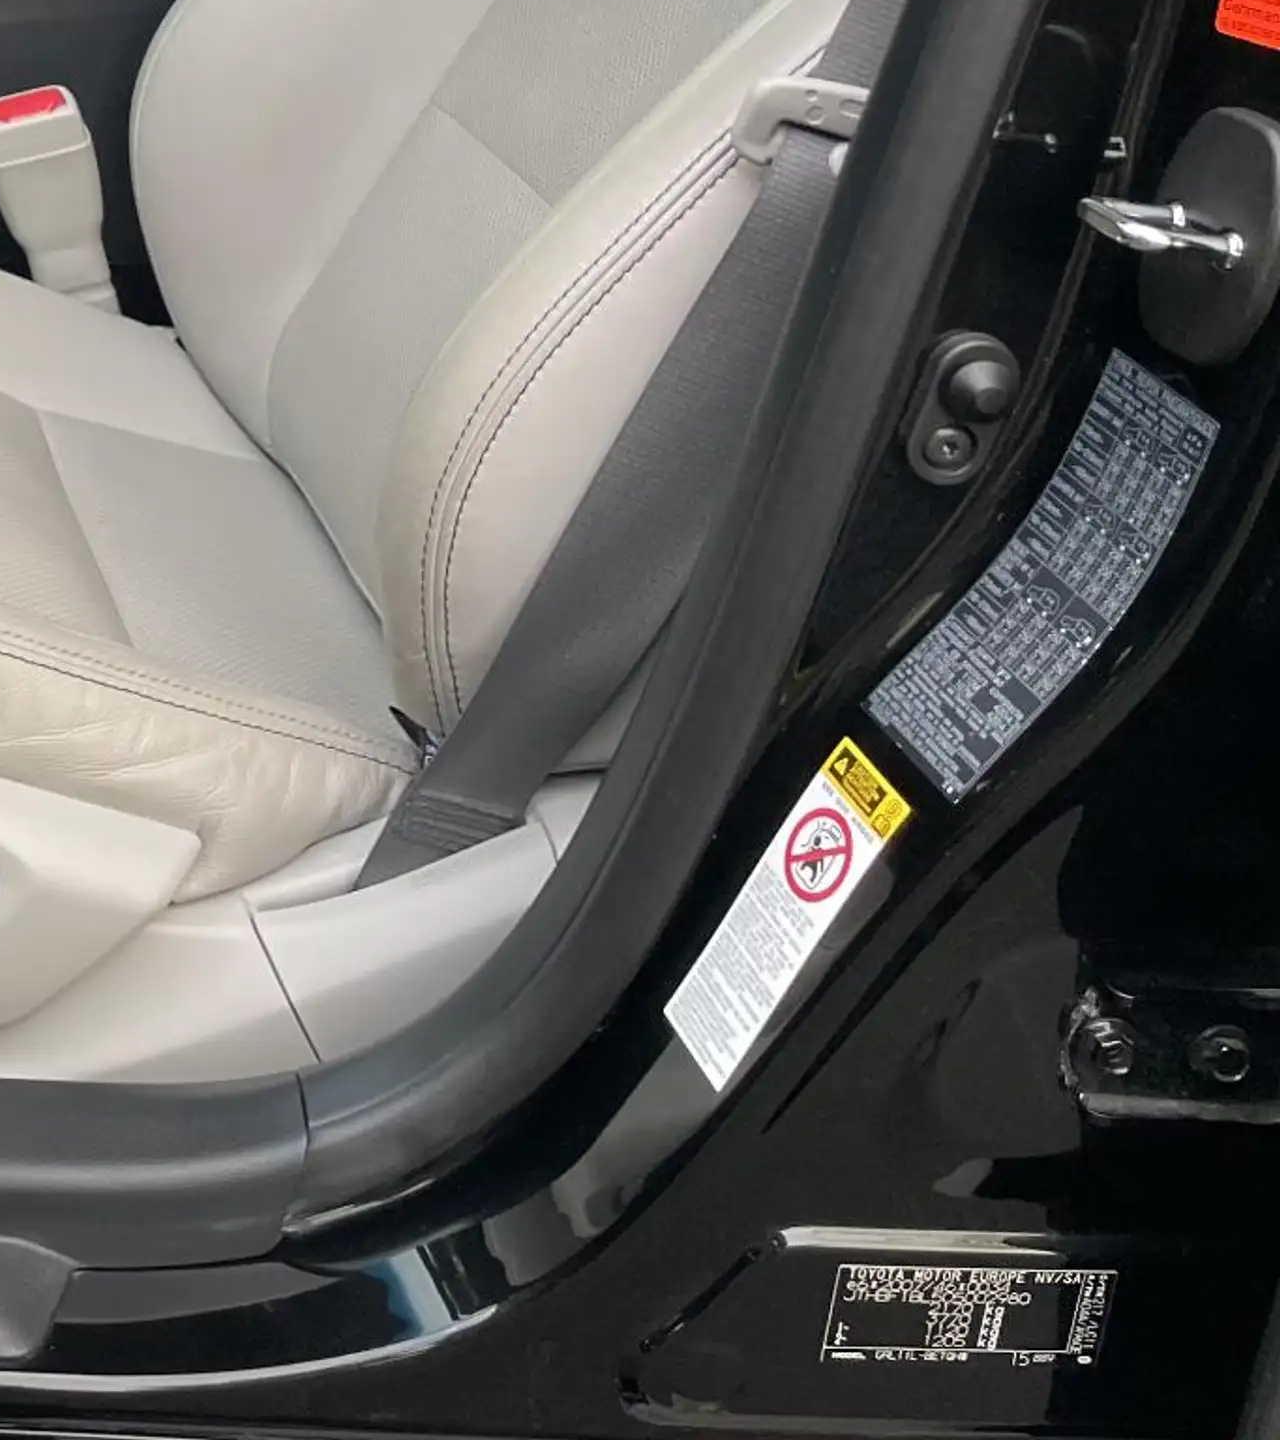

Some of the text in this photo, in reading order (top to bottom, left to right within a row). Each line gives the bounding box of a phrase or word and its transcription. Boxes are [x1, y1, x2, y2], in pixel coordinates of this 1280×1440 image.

[850, 1266, 1081, 1284] TOYOTA MOTOR EUROPE NV/SA
